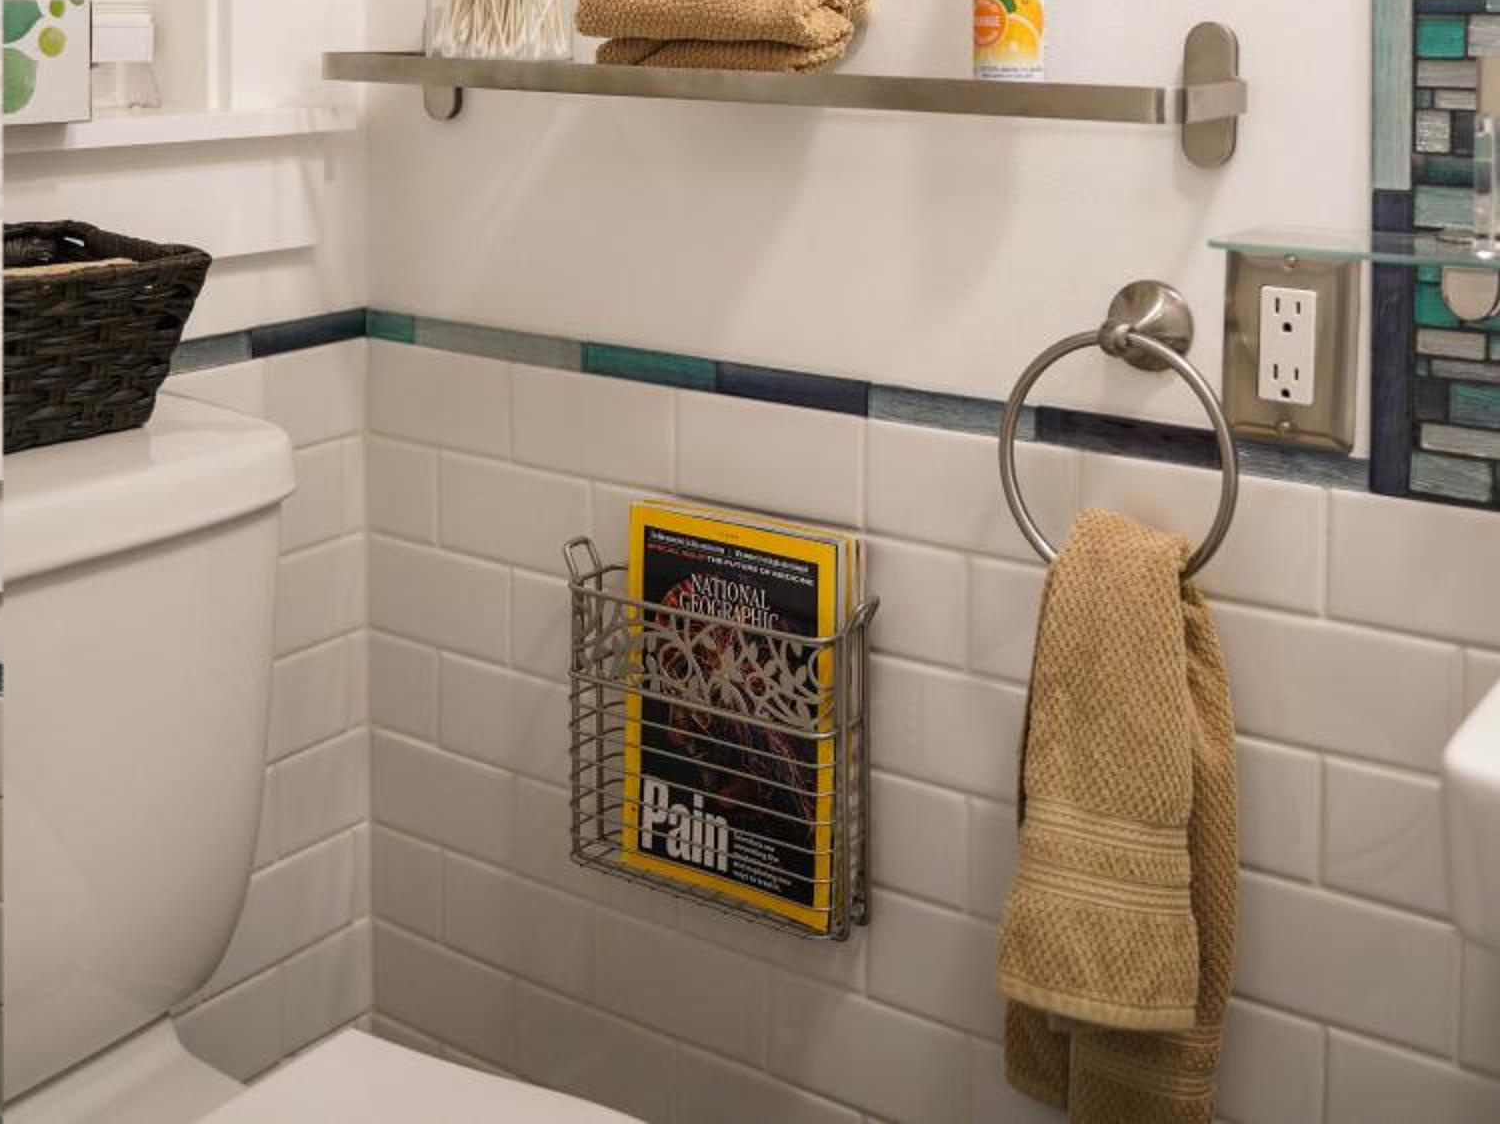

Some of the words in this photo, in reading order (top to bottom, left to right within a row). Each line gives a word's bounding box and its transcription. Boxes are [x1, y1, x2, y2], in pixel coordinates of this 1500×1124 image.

[679, 591, 780, 630] GEOGRAPHIC
[691, 572, 771, 611] NATIONAL
[642, 778, 729, 873] Pain
